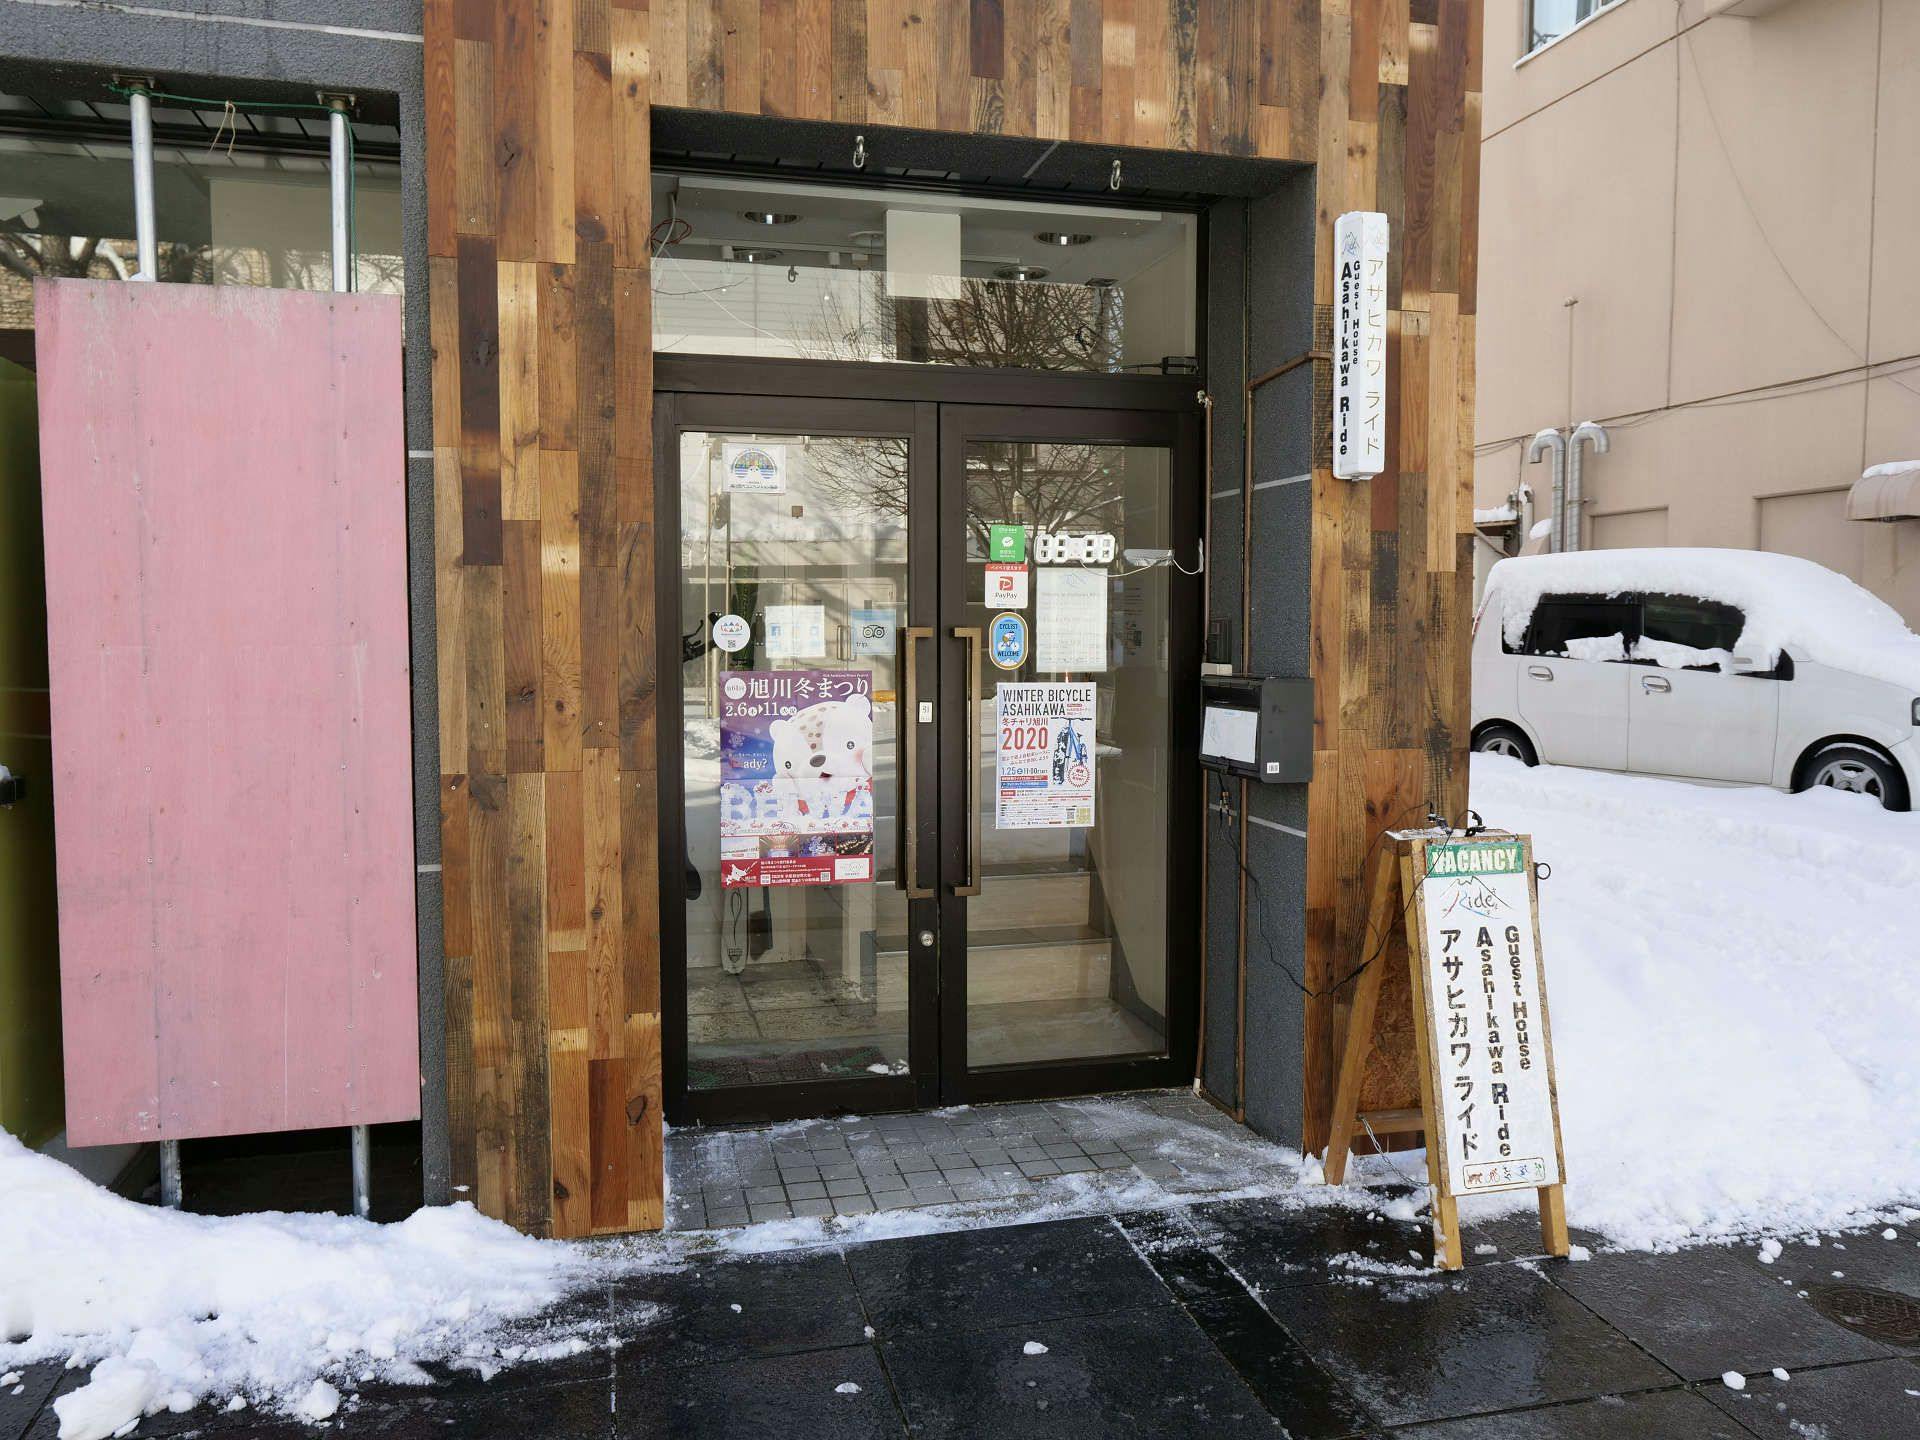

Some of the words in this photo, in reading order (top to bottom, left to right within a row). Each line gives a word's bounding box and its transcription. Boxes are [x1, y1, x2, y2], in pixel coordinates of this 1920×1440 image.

[1353, 260, 1361, 311] Guest
[1340, 262, 1352, 387] Asahikawa
[1352, 319, 1360, 365] House
[1364, 259, 1384, 455] アサヒカワライド
[1339, 396, 1350, 455] Ride
[995, 592, 1018, 600] PayPay
[747, 677, 869, 699] 旭川冬まつり
[1002, 689, 1043, 702] WINTER
[1048, 689, 1092, 702] BICYCLE
[1002, 703, 1066, 716] ASAHIKAWA
[1001, 717, 1049, 726] 冬チャリ旭川
[1001, 727, 1049, 750] 2020
[1432, 848, 1518, 873] VACANCY
[1504, 925, 1522, 997] Guest
[1439, 928, 1479, 1161] アサヒカワライド
[1476, 926, 1504, 1075] Asahikawa
[1491, 1082, 1513, 1157] Ride
[1512, 1001, 1531, 1071] House
